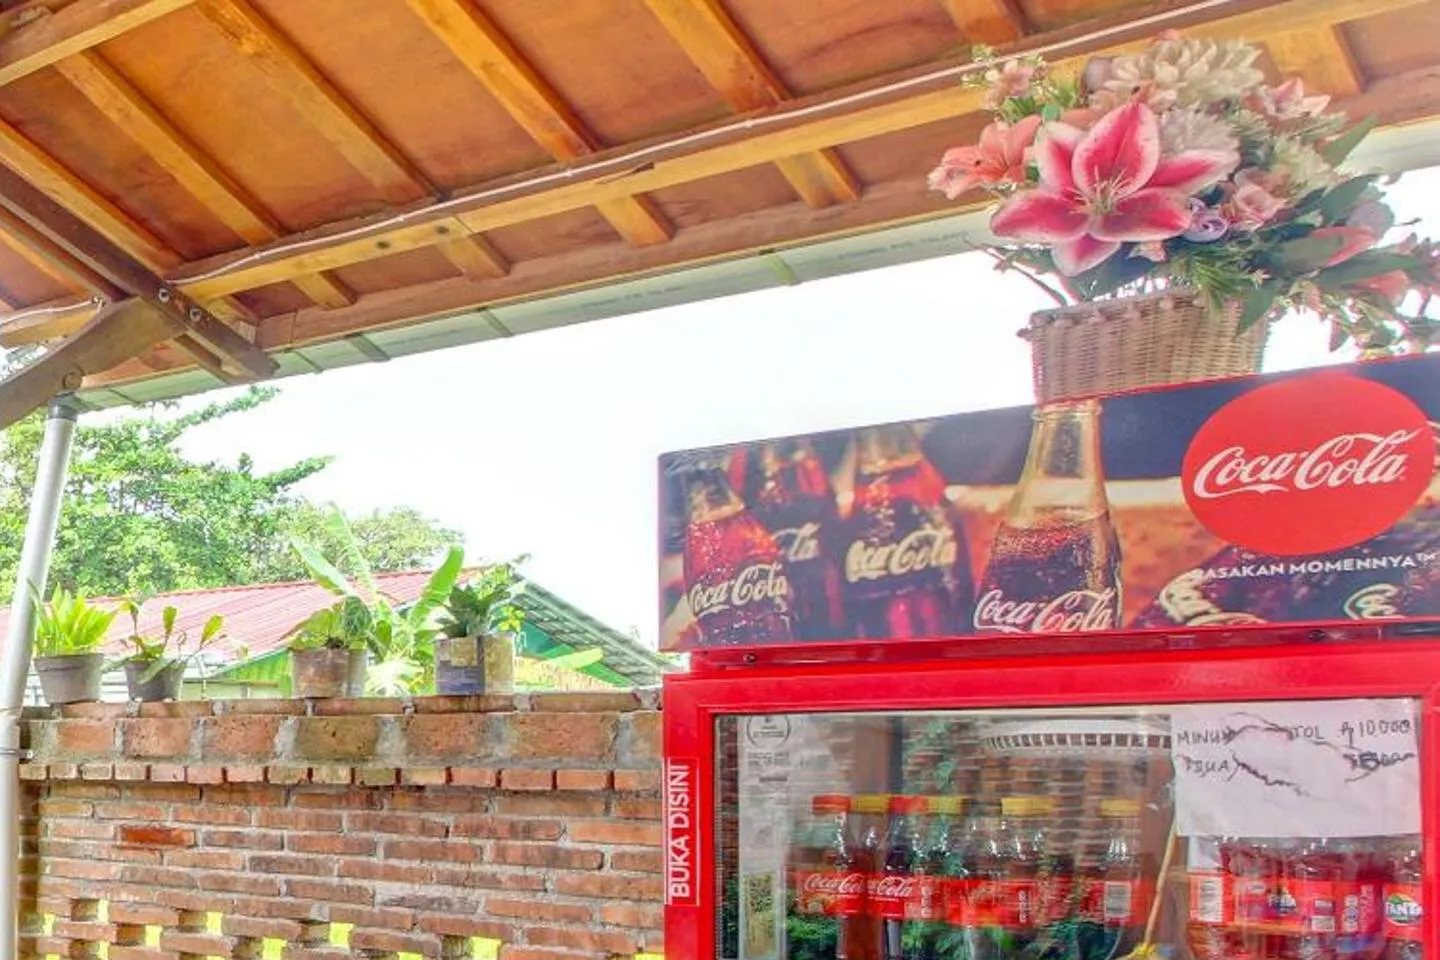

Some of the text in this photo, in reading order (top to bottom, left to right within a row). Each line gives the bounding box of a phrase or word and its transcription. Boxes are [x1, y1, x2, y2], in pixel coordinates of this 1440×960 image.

[1192, 428, 1424, 499] Coca-Cola
[973, 587, 1117, 634] Coca-Cola
[668, 763, 691, 899] BUKA DISINI
